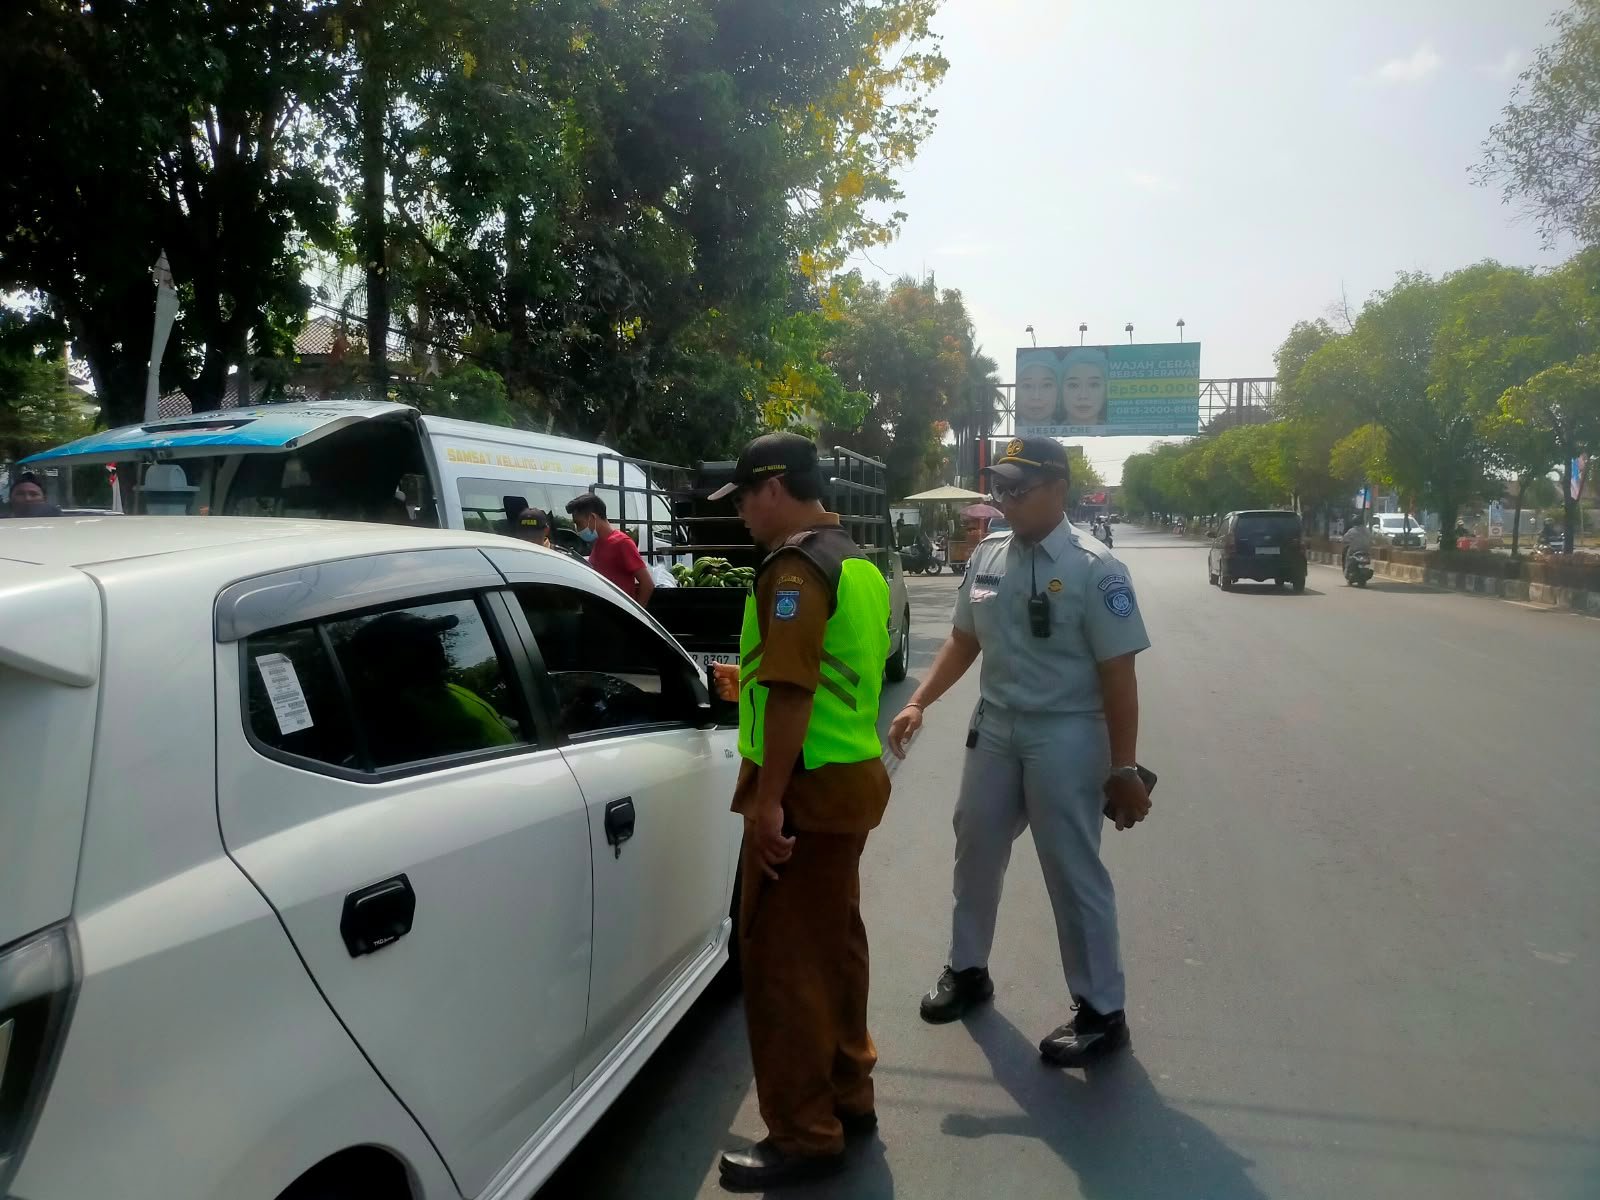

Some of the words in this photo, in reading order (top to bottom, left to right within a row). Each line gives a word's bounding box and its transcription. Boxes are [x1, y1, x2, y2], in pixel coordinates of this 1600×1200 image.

[1110, 361, 1154, 370] WAJAH
[1110, 370, 1145, 378] BEBAS
[1148, 368, 1199, 377] JERAWAT
[1110, 382, 1197, 396] Rp500.000
[1027, 426, 1057, 435] MESO
[1061, 426, 1089, 434] ACNE
[447, 448, 491, 464] SAMSAT
